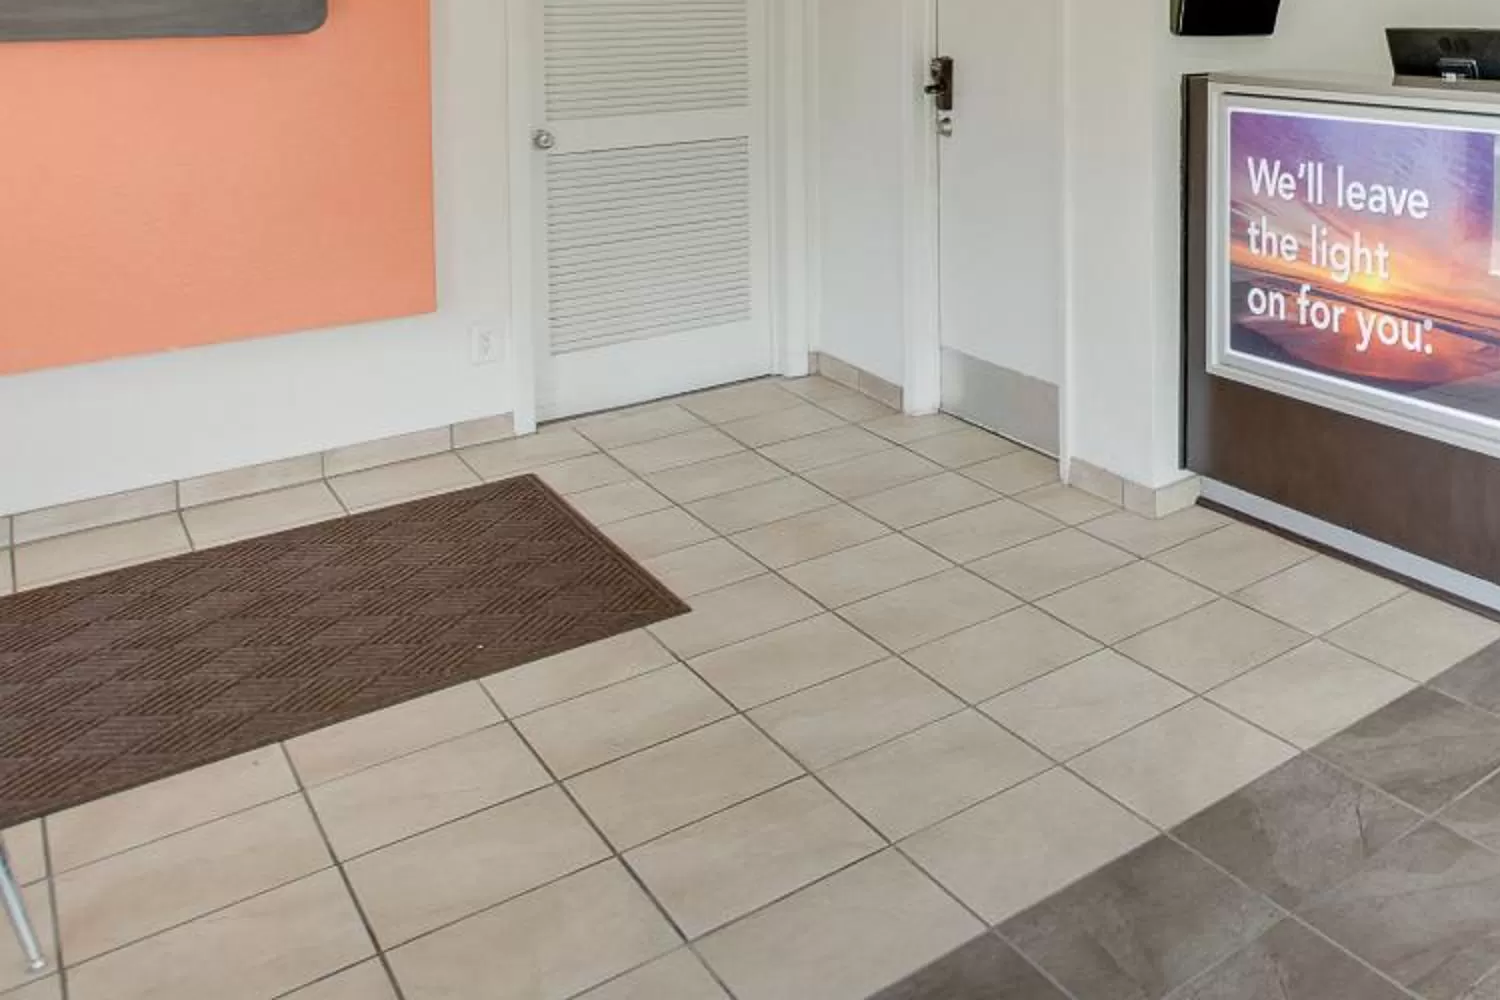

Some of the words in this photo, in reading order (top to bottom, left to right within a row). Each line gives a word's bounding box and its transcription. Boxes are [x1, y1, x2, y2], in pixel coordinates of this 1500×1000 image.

[1247, 156, 1324, 205] We'll
[1337, 164, 1429, 219] leave
[1247, 216, 1298, 261] the
[1311, 223, 1389, 283] light
[1247, 285, 1286, 321] on
[1296, 284, 1345, 333] for
